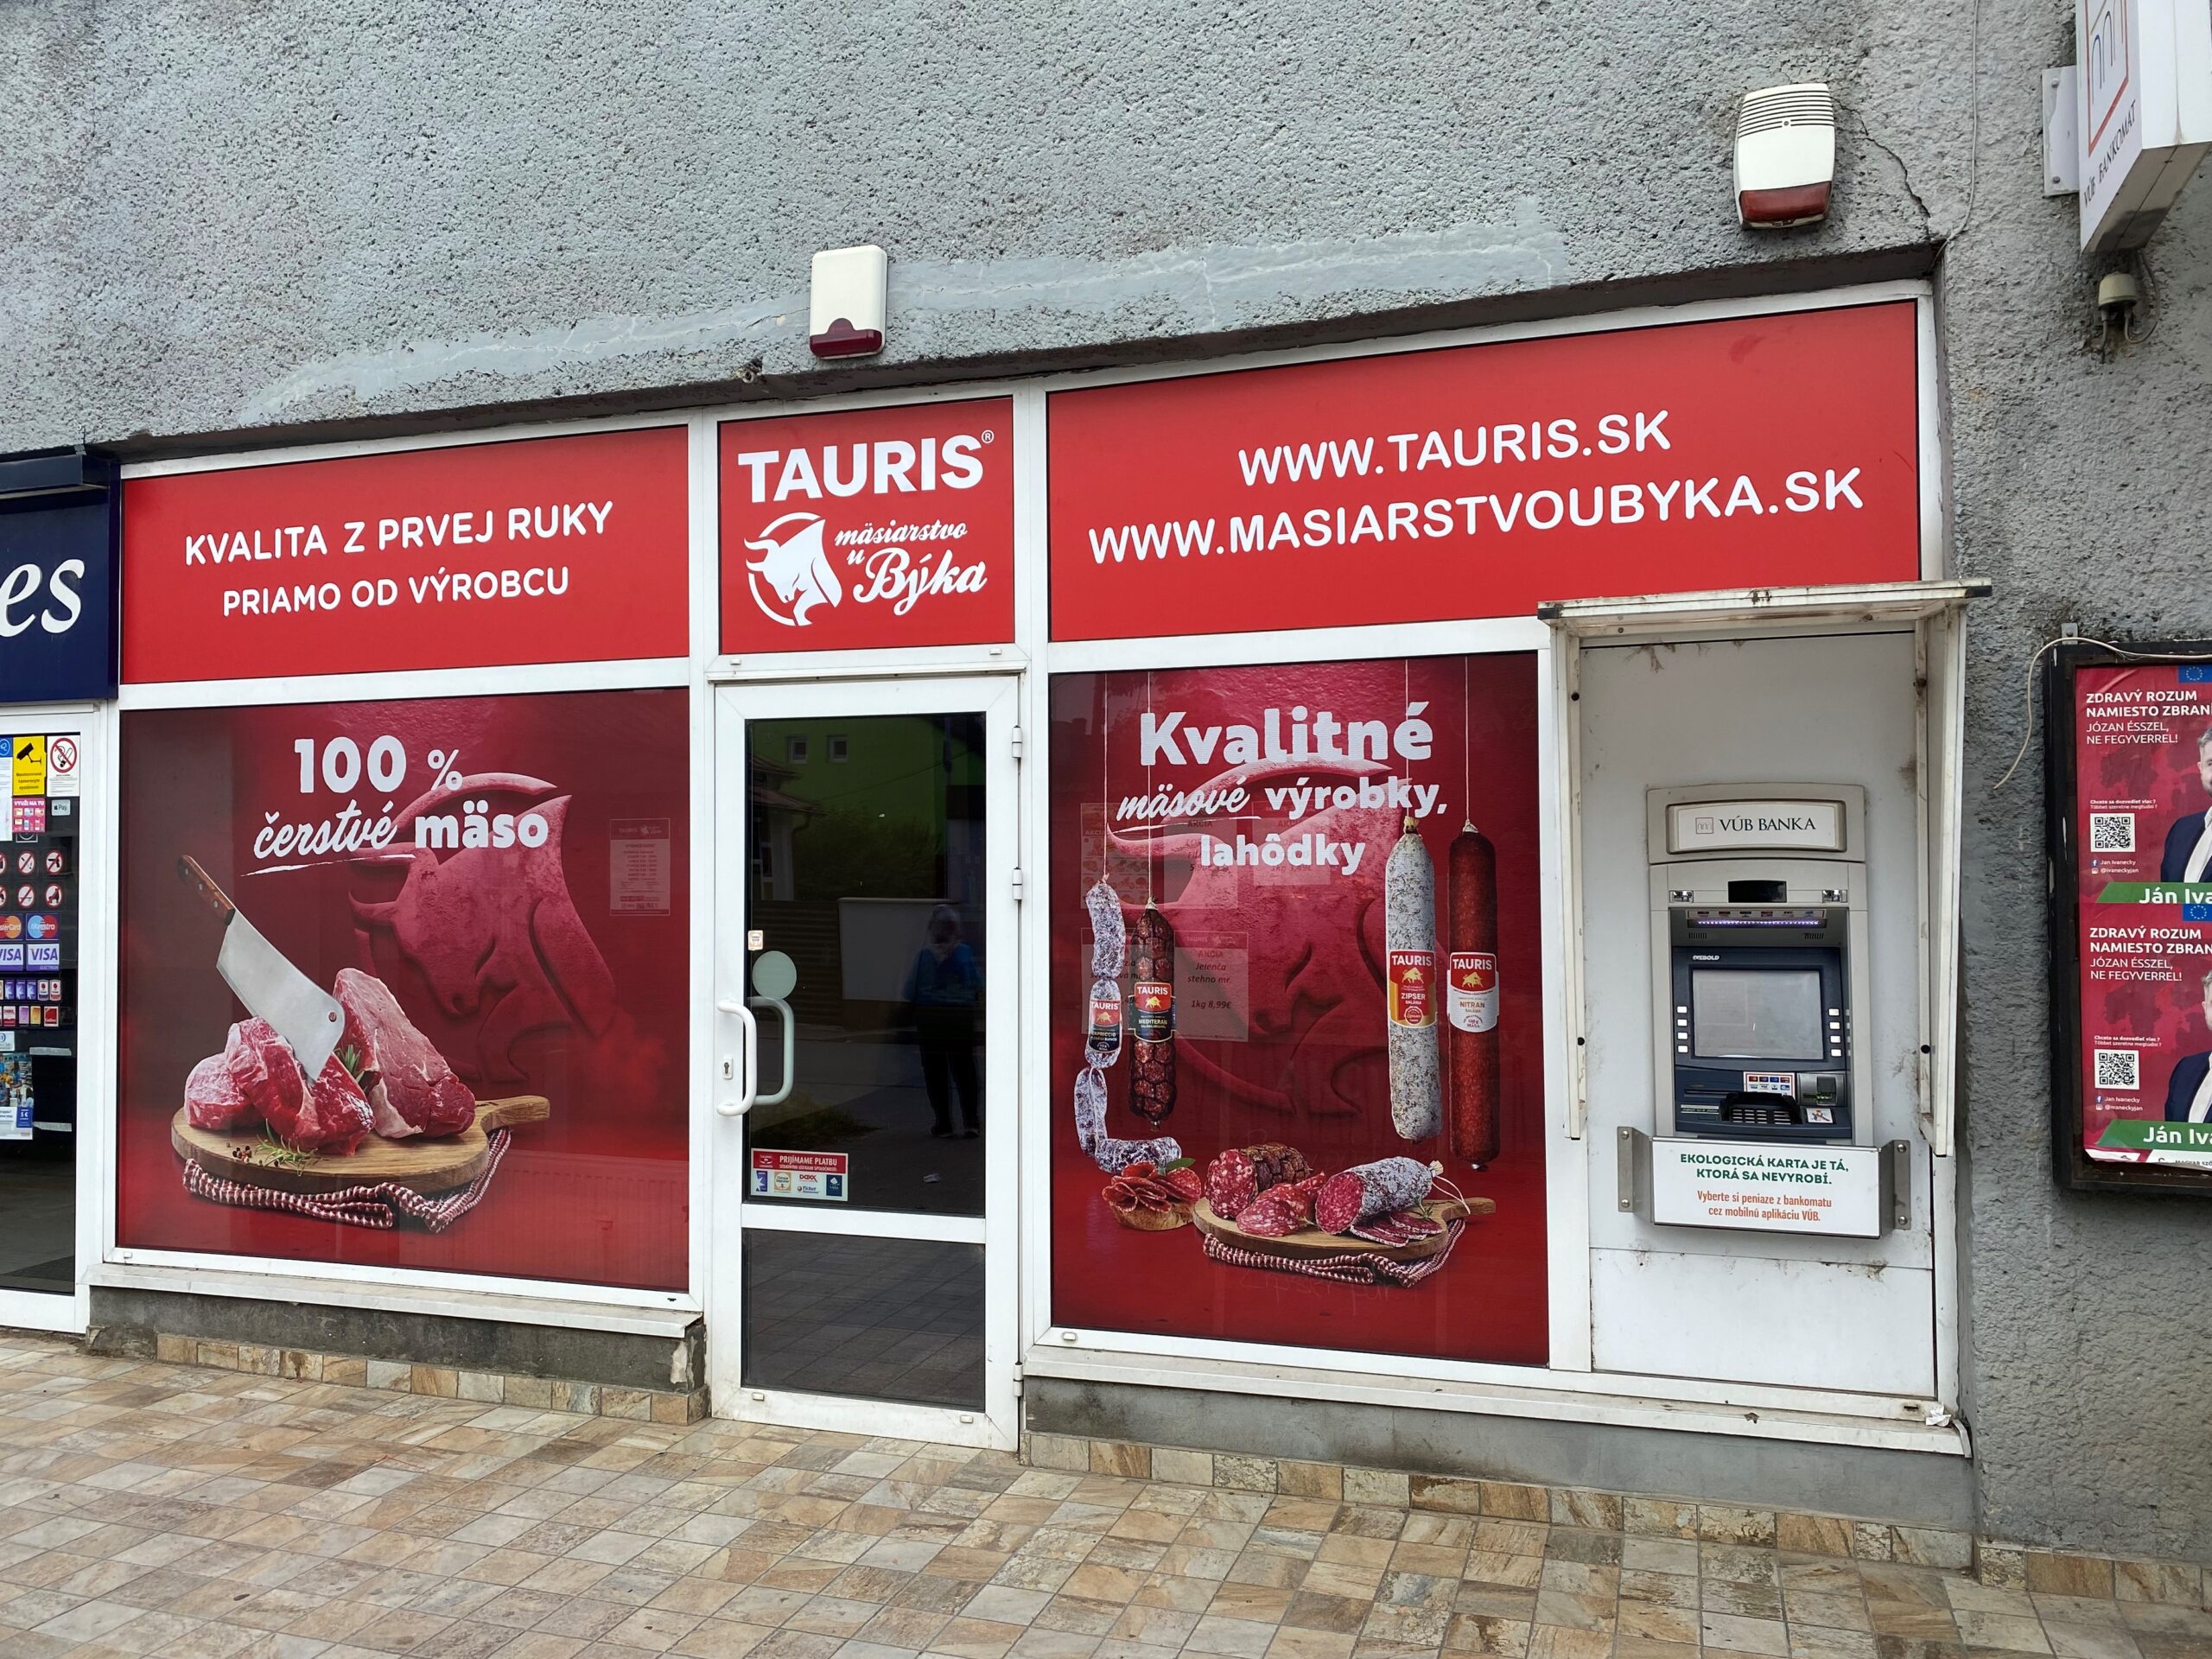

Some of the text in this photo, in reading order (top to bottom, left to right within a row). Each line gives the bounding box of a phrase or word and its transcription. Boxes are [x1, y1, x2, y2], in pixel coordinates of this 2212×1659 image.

[1237, 410, 1673, 486] WWW.TAURIS.SK
[1088, 467, 1864, 565] WWW.MASIARSTVOUBYKA.SK
[185, 500, 613, 566] KVALITA Z PRVEJ RUKY
[834, 518, 968, 546] mäsiarstvo
[847, 549, 865, 565] u
[853, 546, 987, 616] Býka
[223, 566, 570, 618] PRIAMO OD VÝROBCU
[2086, 689, 2197, 703] ZDRAVÝ ROZUM
[2087, 706, 2159, 717] NAMIESTO
[1140, 701, 1433, 766] Kvalitné
[2087, 721, 2170, 733] JÓZAN ÉSSZEL,
[2087, 734, 2178, 744] NE FEGYVERREL!
[294, 734, 463, 793] 100 %
[1116, 775, 1447, 822] mäsové výrobky,
[253, 799, 549, 859] čerstvé mäso
[1719, 816, 1816, 831] VÚB BANKA
[1200, 833, 1365, 876] lahôdky
[2139, 887, 2177, 904] Ján
[2089, 925, 2201, 939] ZDRAVÝ ROZUM
[29, 948, 58, 960] VISA
[2090, 942, 2163, 953] NAMIESTO
[1391, 955, 1432, 966] TAURIS
[1452, 958, 1492, 970] TAURIS
[2090, 956, 2173, 969] JÓZAN ÉSSZEL,
[2108, 971, 2182, 982] FEGYVERREL!
[1191, 1001, 1232, 1009] 1kg 8,99€
[2143, 1126, 2212, 1145] Ján Iv
[779, 1154, 812, 1165] PRIJÍMAME
[1681, 1154, 1849, 1172] EKOLOGICKÁ KARTA JE TÁ,
[1696, 1168, 1833, 1185] KTORÁ SA NEVYROBÍ.
[1697, 1191, 1730, 1203] Vyberte
[1732, 1192, 1739, 1202] si
[1741, 1193, 1775, 1205] peniaze
[1783, 1196, 1832, 1208] bankomatu
[1725, 1206, 1760, 1217] mobilnú
[1761, 1208, 1800, 1220] aplikáciu
[1802, 1210, 1821, 1221] VÚB.
